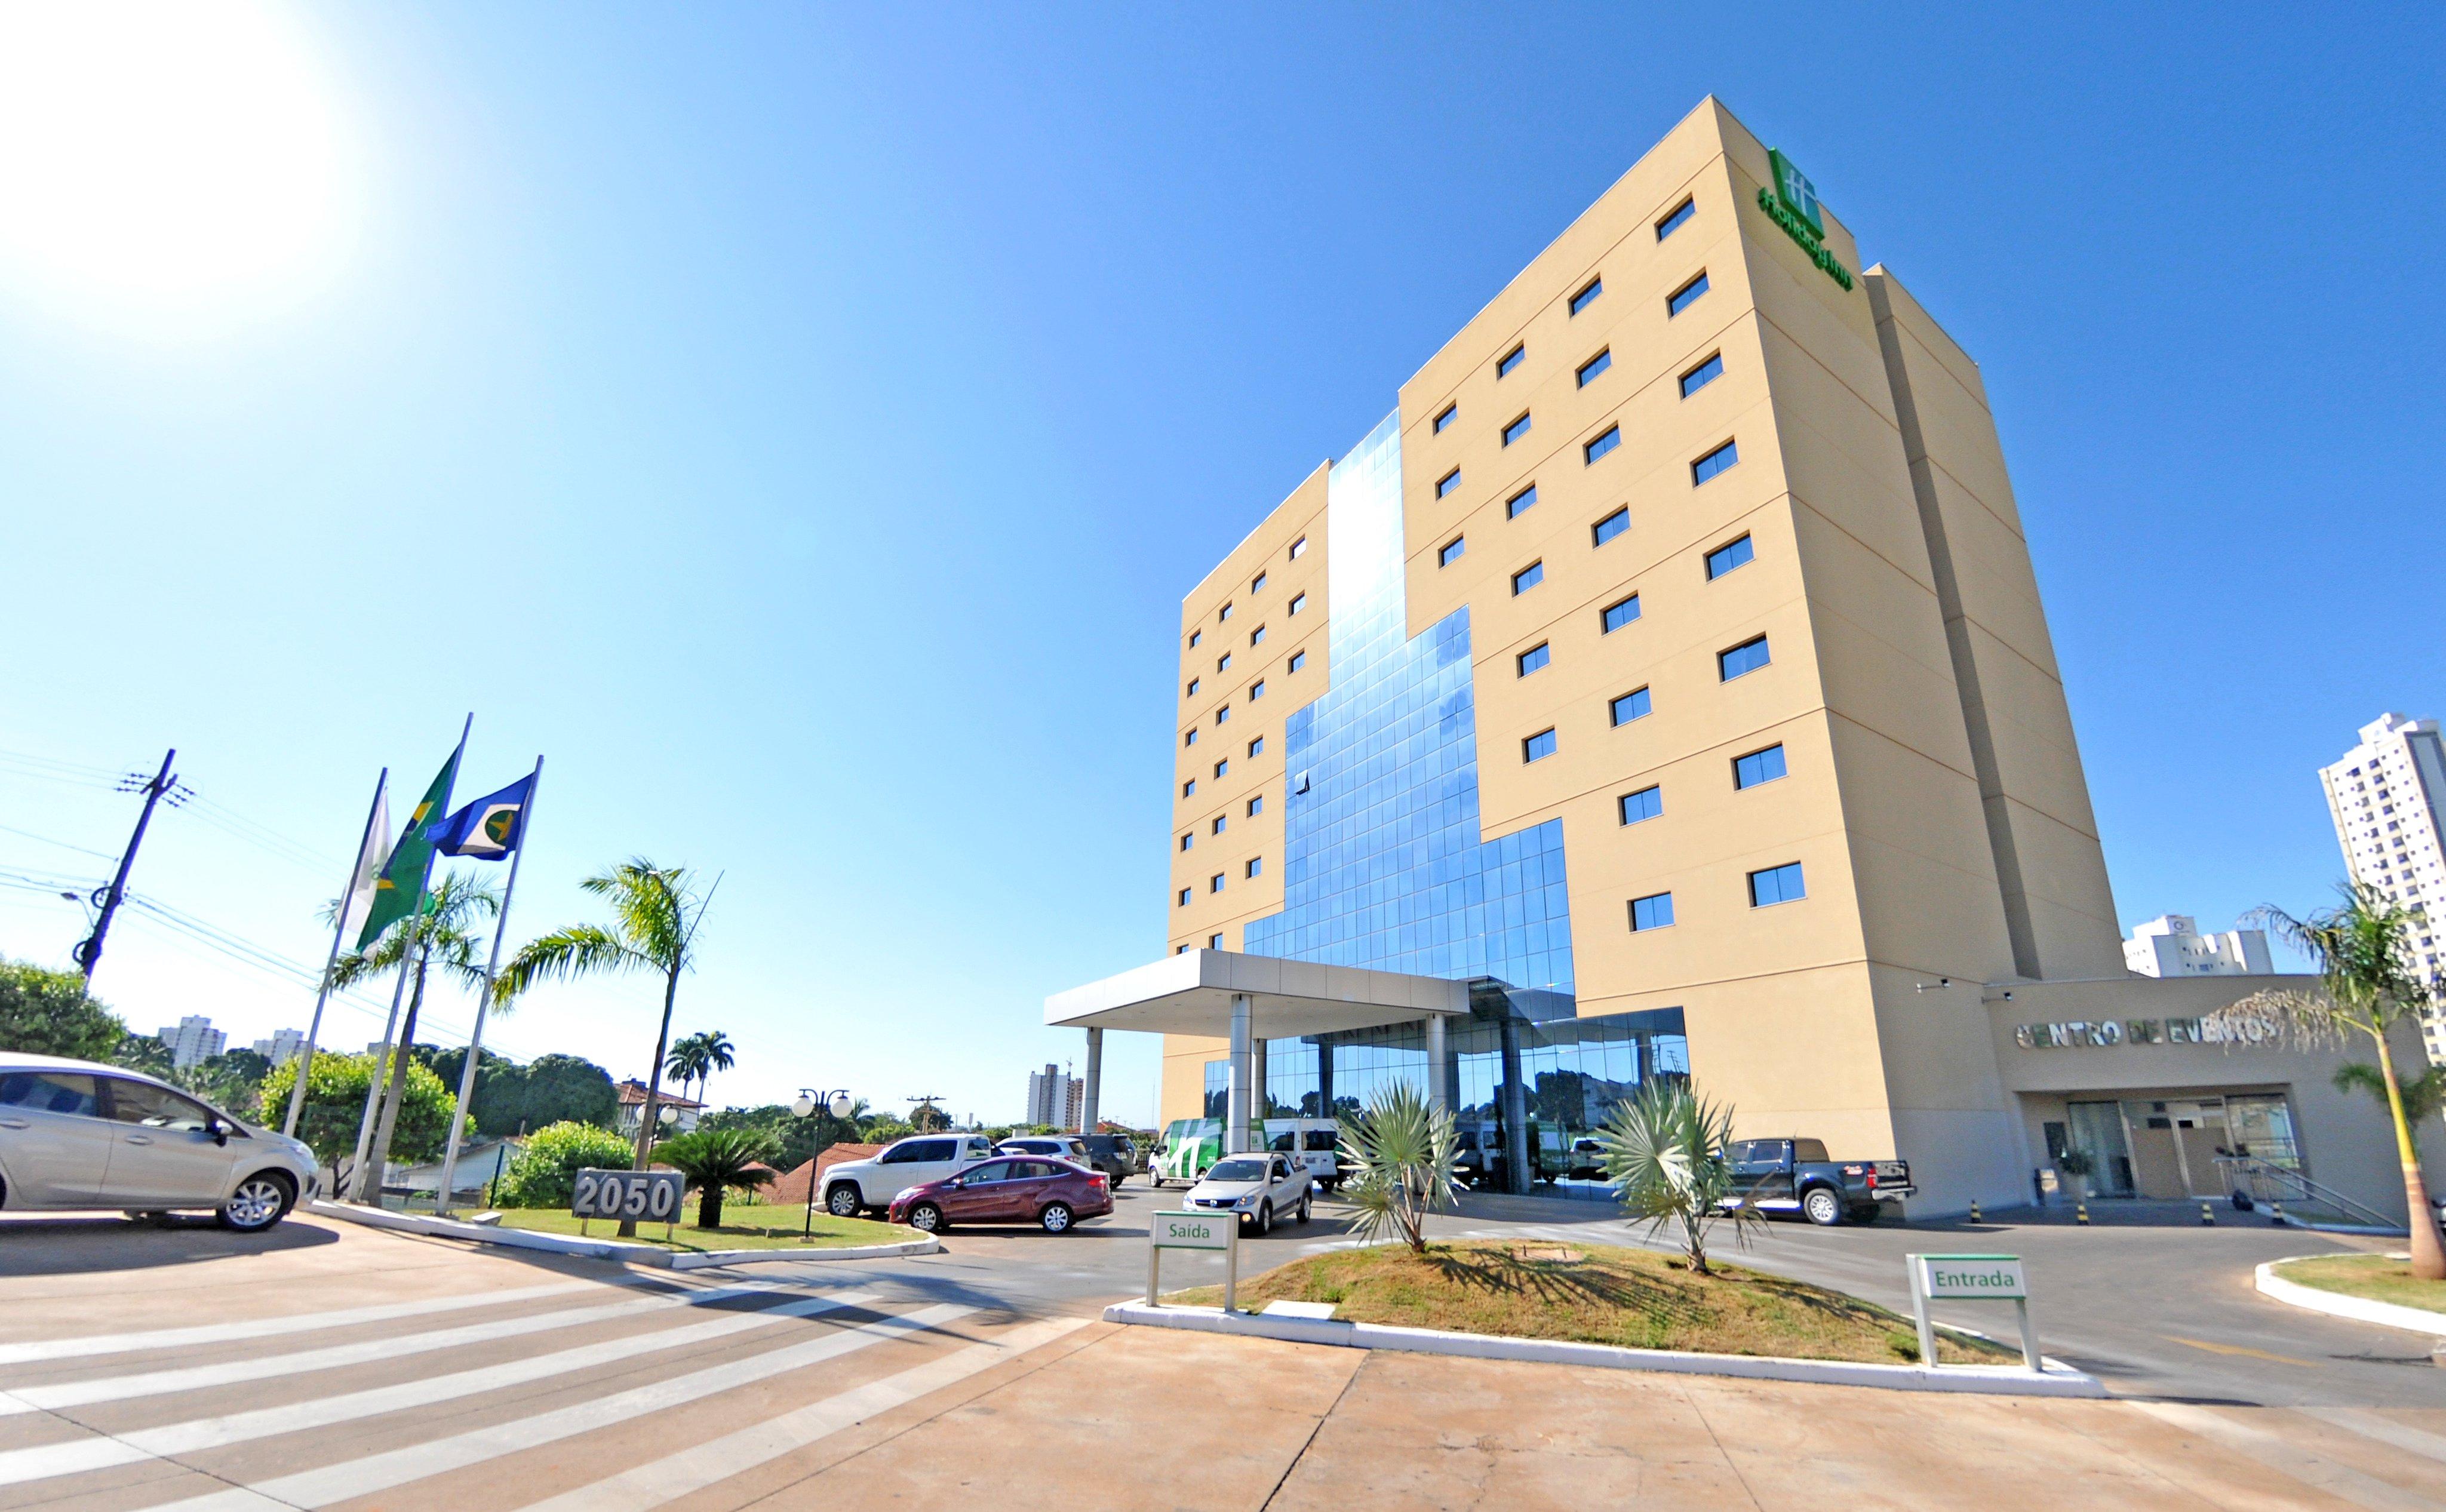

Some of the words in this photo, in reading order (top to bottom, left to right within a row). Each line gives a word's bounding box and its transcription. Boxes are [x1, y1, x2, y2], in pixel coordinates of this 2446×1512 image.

[2017, 1019, 2121, 1048] CENTRO
[2127, 1019, 2163, 1044] DE
[2166, 1017, 2277, 1043] EVENTOS
[574, 1176, 674, 1217] 2050
[1935, 1270, 2015, 1287] Entrada
